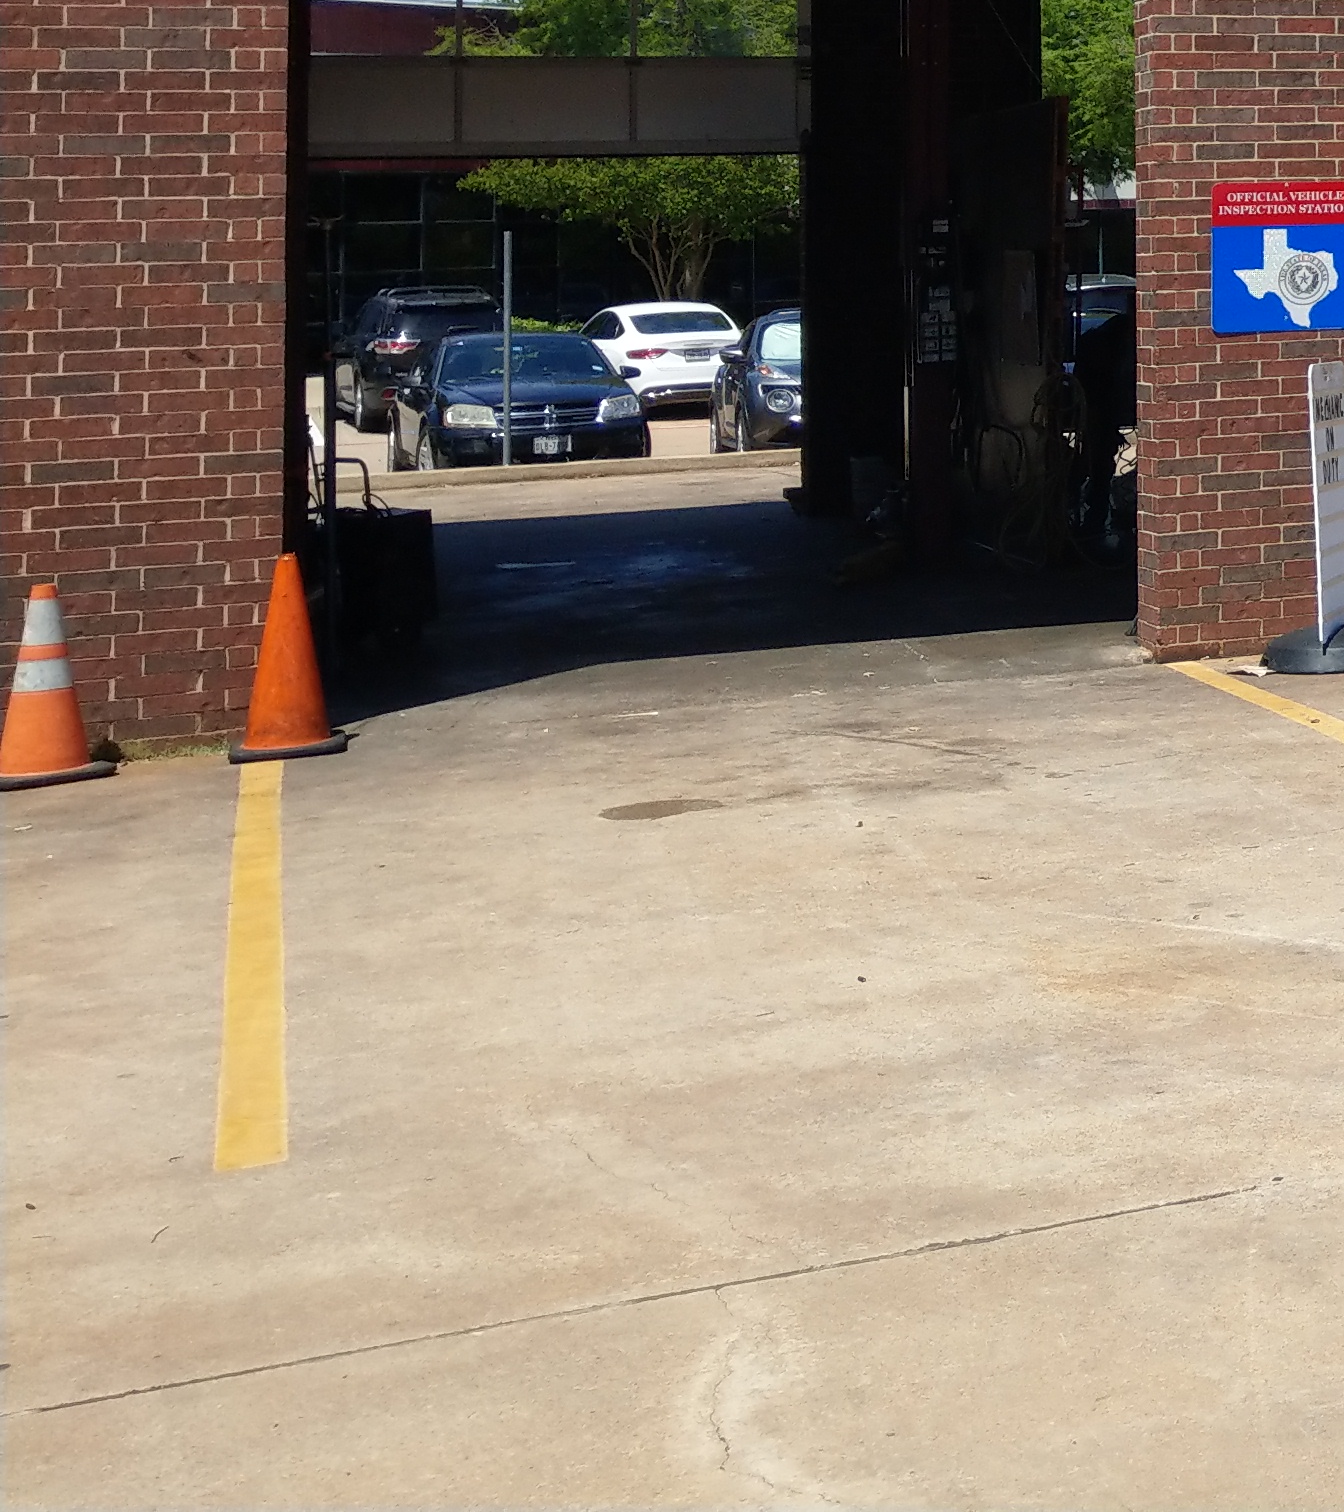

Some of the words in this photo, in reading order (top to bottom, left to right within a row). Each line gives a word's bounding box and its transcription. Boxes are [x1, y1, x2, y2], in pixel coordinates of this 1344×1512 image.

[1226, 191, 1287, 202] OFFICIAL
[1290, 190, 1344, 201] VEHICLE
[1218, 205, 1296, 215] INSPECTION
[1315, 393, 1344, 422] MECHANIC
[1326, 426, 1335, 451] ON
[1323, 457, 1339, 485] DUTY
